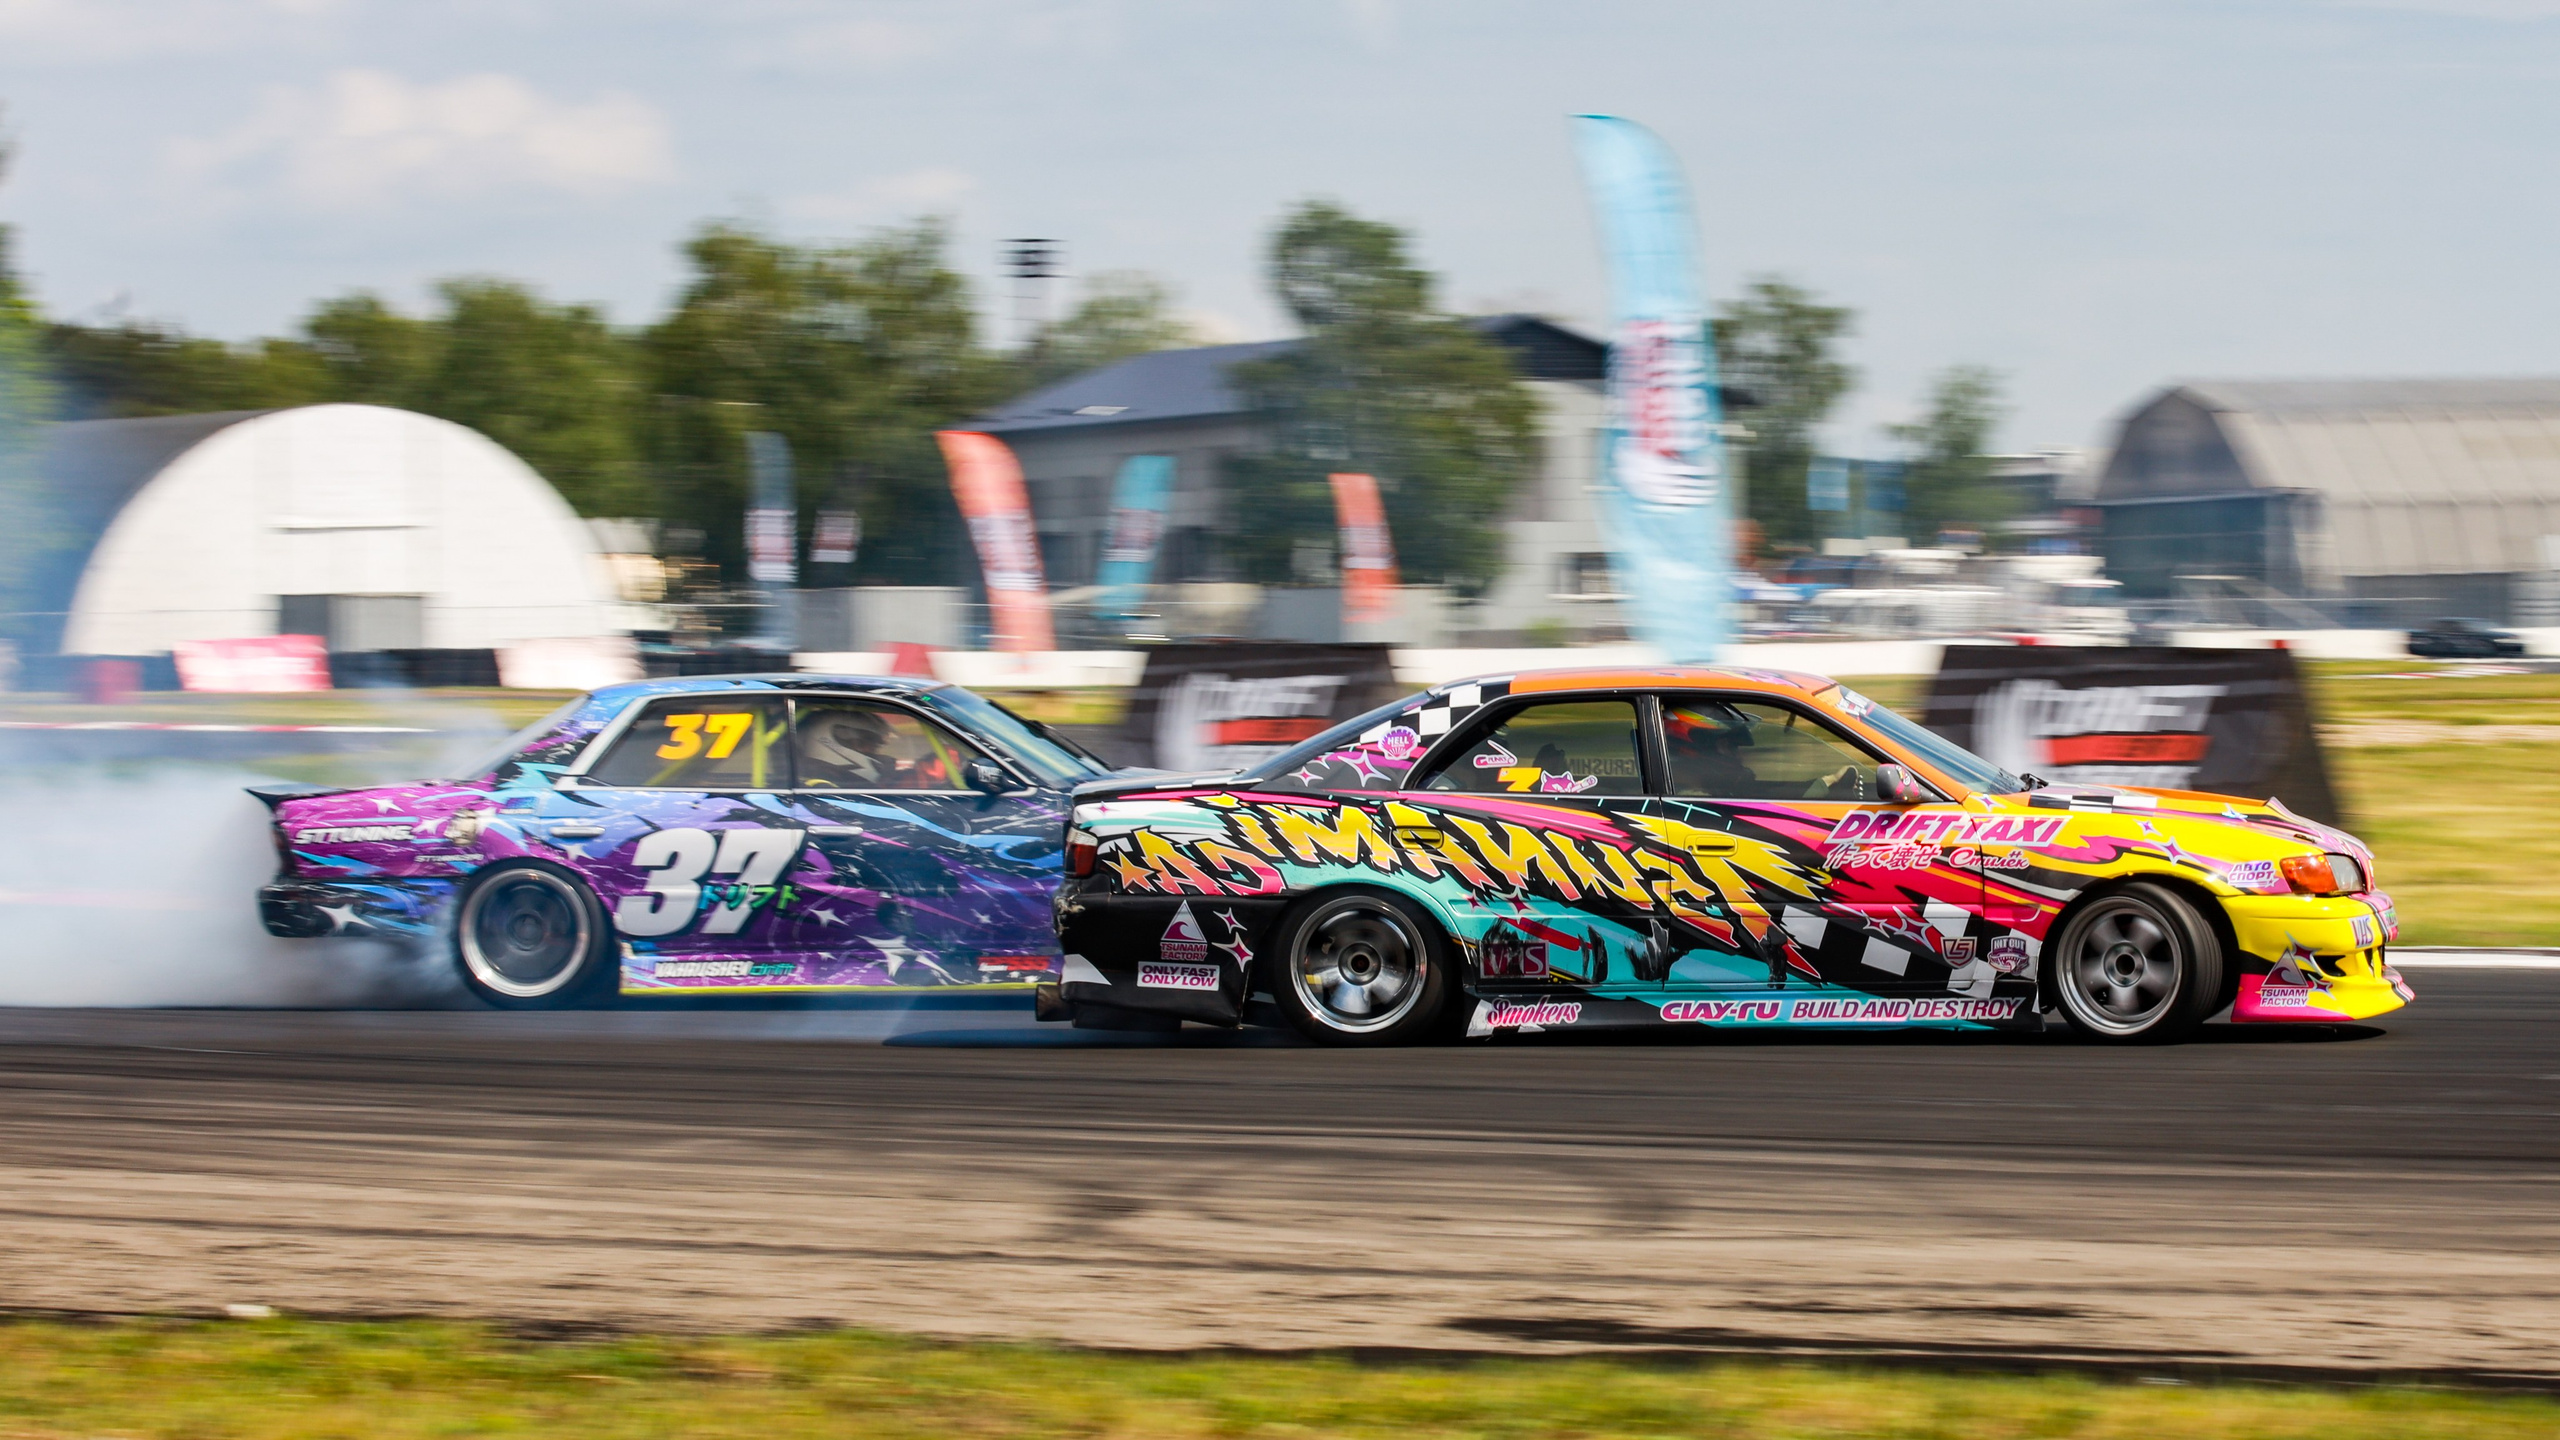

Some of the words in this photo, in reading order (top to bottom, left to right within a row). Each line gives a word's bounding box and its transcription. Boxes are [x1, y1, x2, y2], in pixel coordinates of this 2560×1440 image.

[657, 712, 753, 759] 37
[1387, 736, 1409, 745] HELL
[2233, 862, 2272, 871] АВТО
[2229, 871, 2274, 880] СПОРТ
[614, 828, 806, 936] 37
[700, 883, 801, 911] ドリフト
[2352, 917, 2373, 946] VHS
[1161, 943, 1207, 952] TSUNAMI
[1161, 951, 1207, 960] FACTORY
[1141, 965, 1180, 976] ONLY
[1181, 967, 1216, 977] FAST
[1141, 974, 1180, 985] ONLY
[1181, 976, 1216, 987] LOW
[2260, 988, 2308, 997] TSUNAMI
[2261, 996, 2307, 1006] FACTORY
[1487, 996, 1580, 1026] Smokers
[1793, 1001, 1859, 1018] BUILD
[1861, 1001, 1910, 1018] AND
[1913, 1000, 2019, 1019] DESTROY
